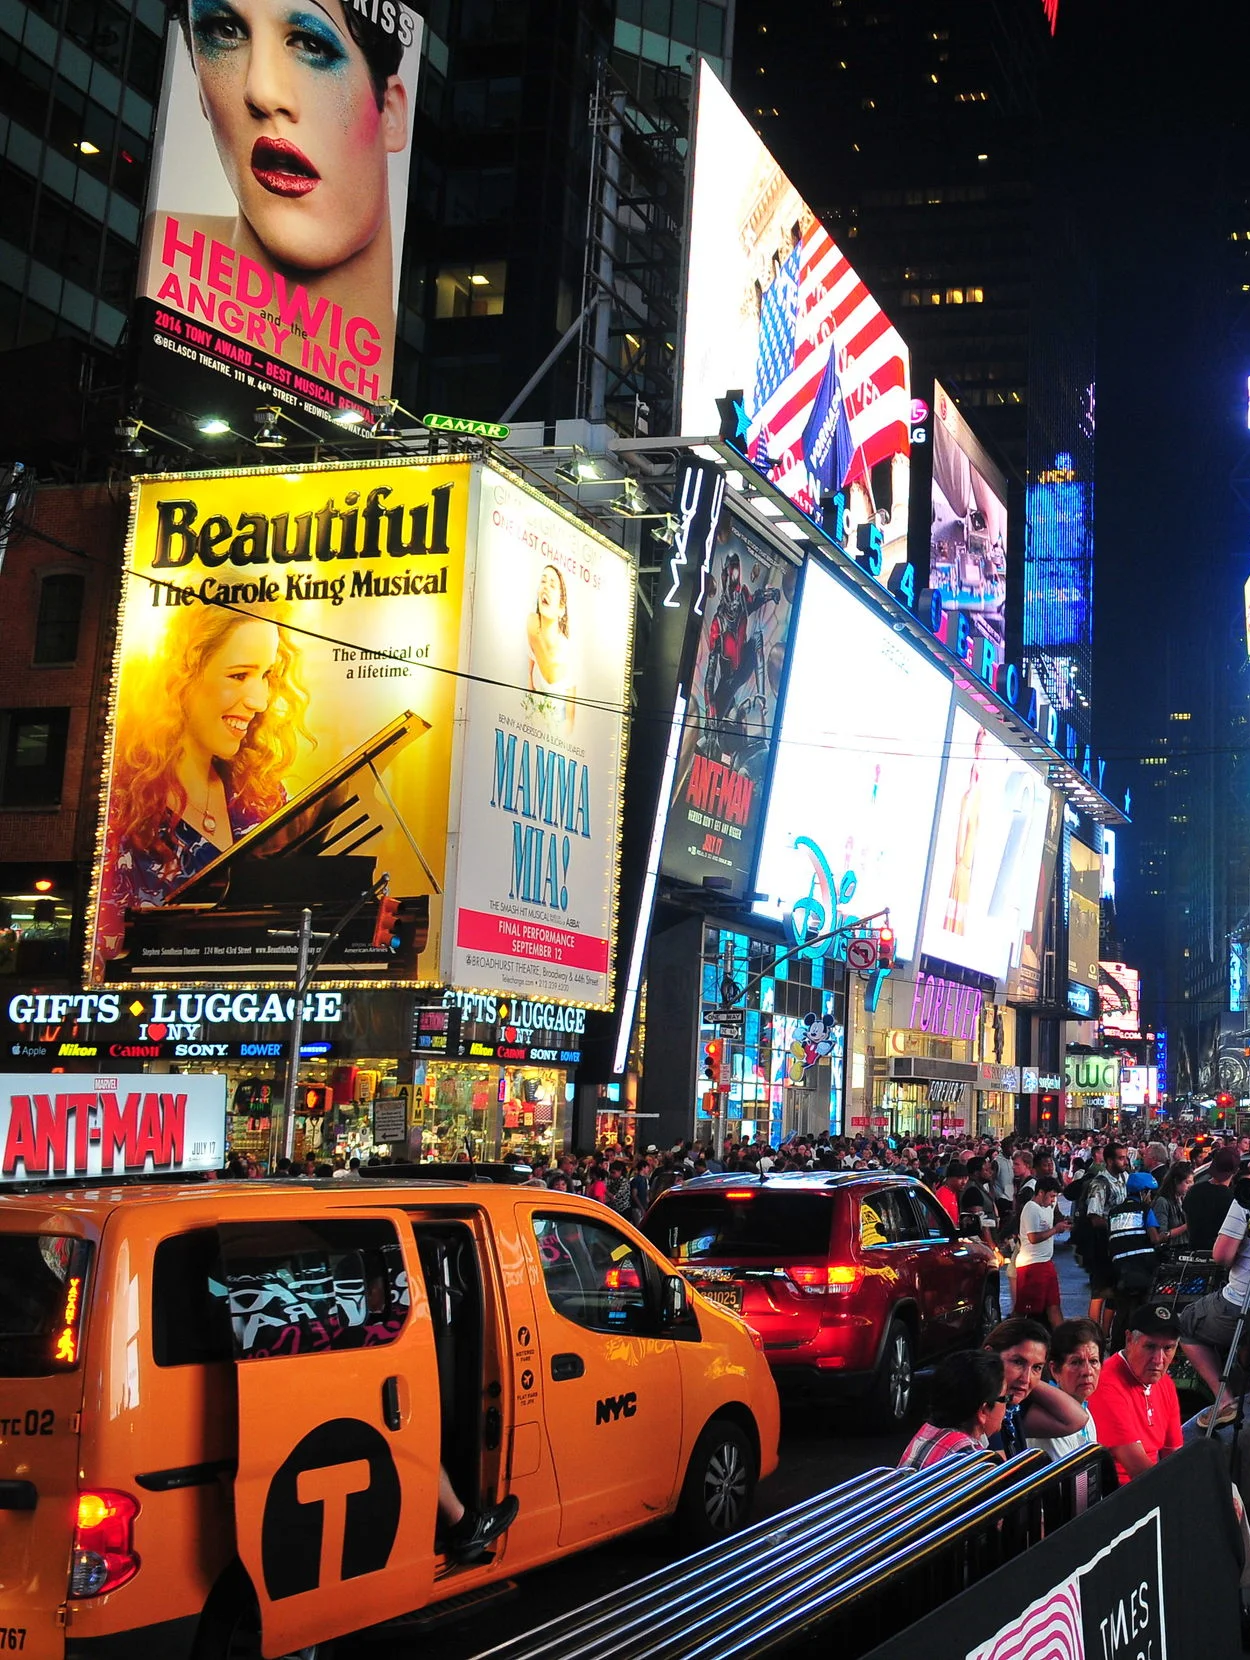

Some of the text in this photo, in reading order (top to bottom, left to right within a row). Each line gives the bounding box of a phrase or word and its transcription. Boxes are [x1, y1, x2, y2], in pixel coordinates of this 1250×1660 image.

[343, 0, 414, 47] RISS
[161, 216, 382, 367] HEDWIG
[157, 272, 379, 401] ANGRY INCH
[260, 309, 308, 340] and the
[155, 310, 182, 335] 2014
[184, 323, 213, 348] TONY
[214, 338, 253, 366] AWARD
[266, 362, 292, 385] BEST
[294, 375, 336, 407] MUSICAL
[162, 339, 197, 361] BELASCO
[234, 369, 246, 382] 111
[247, 376, 256, 389] W.
[272, 387, 298, 406] STREET
[430, 416, 502, 437] LAMAR
[151, 481, 454, 568] Beautiful
[541, 541, 576, 575] CHANCE
[580, 565, 590, 583] TO
[150, 566, 449, 607] The Carole King Musical
[333, 644, 430, 662] The musical of
[346, 664, 412, 679] a lifetime.
[490, 728, 592, 840] MAMMA
[685, 753, 755, 826] ANT-MAN
[508, 820, 571, 912] MIA!
[500, 902, 519, 915] SMASH
[520, 905, 529, 916] HIT
[529, 909, 549, 922] MUSICAL
[499, 921, 575, 948] FINAL PERFORMANCE
[512, 939, 562, 960] SEPTEMBER 12
[204, 946, 214, 955] 124
[214, 946, 225, 955] West
[237, 946, 252, 955] Street
[472, 956, 514, 973] BROADHURST
[543, 966, 568, 983] Broadway
[8, 992, 342, 1023] GIFTS LUGGAGE
[510, 999, 586, 1034] LUGGAGE
[910, 971, 983, 1040] FOREVER
[139, 1024, 201, 1041] I NY
[515, 1028, 534, 1045] NY
[22, 1045, 47, 1057] Apple
[58, 1044, 98, 1057] Nikon
[110, 1044, 160, 1058] Canon
[175, 1044, 227, 1057] SONY
[240, 1044, 281, 1056] BOWER
[470, 1042, 581, 1062] Nikon Canon SONY BOWER
[94, 1079, 117, 1089] MARVEL
[929, 1080, 958, 1102] FOREVER
[415, 1086, 423, 1119] ATM
[2, 1093, 188, 1173] ANT-MAN
[191, 1142, 217, 1155] JULY 17
[64, 1278, 80, 1325] VACANT
[24, 1410, 55, 1436] 02
[596, 1392, 636, 1425] NYC
